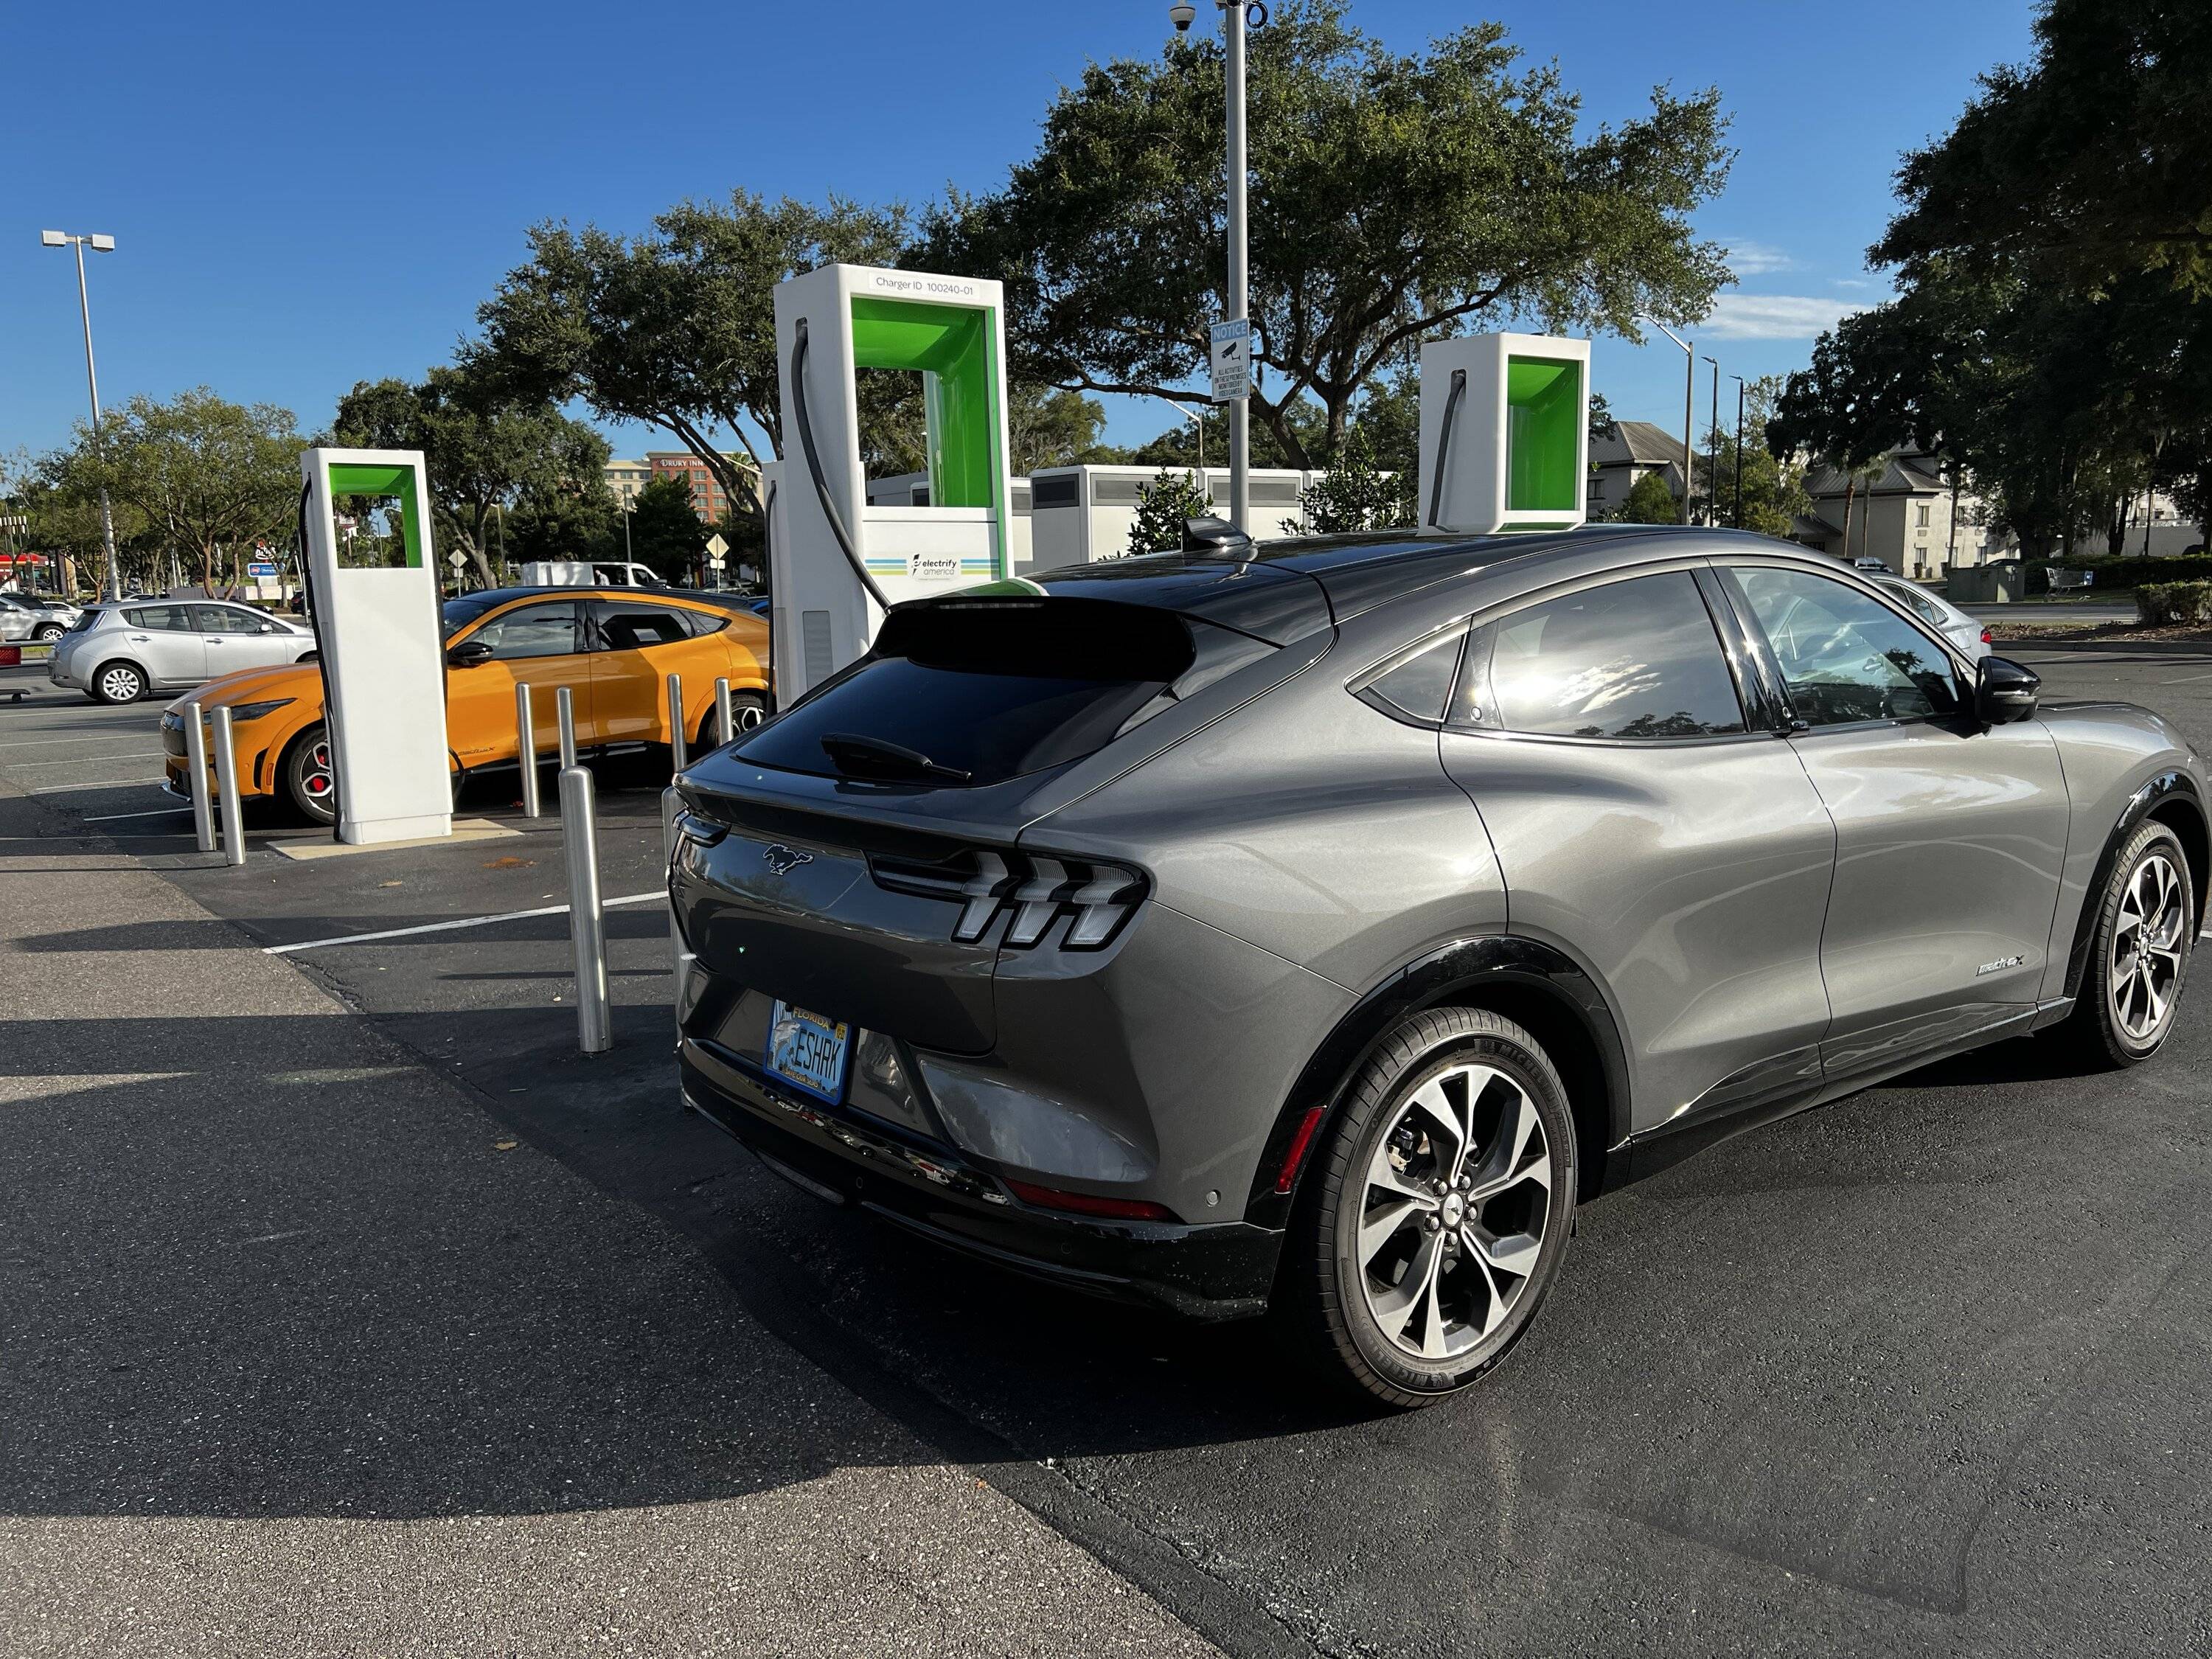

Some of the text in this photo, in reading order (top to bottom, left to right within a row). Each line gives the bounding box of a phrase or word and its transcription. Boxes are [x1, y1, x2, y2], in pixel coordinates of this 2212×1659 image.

[876, 276, 973, 296] Charger ID 100240-01
[1214, 322, 1246, 341] NOTICE
[660, 459, 686, 467] DRURY
[922, 559, 957, 568] electrify
[793, 1006, 830, 1032] FLORIDA
[1498, 1043, 1559, 1111] MICHELIN
